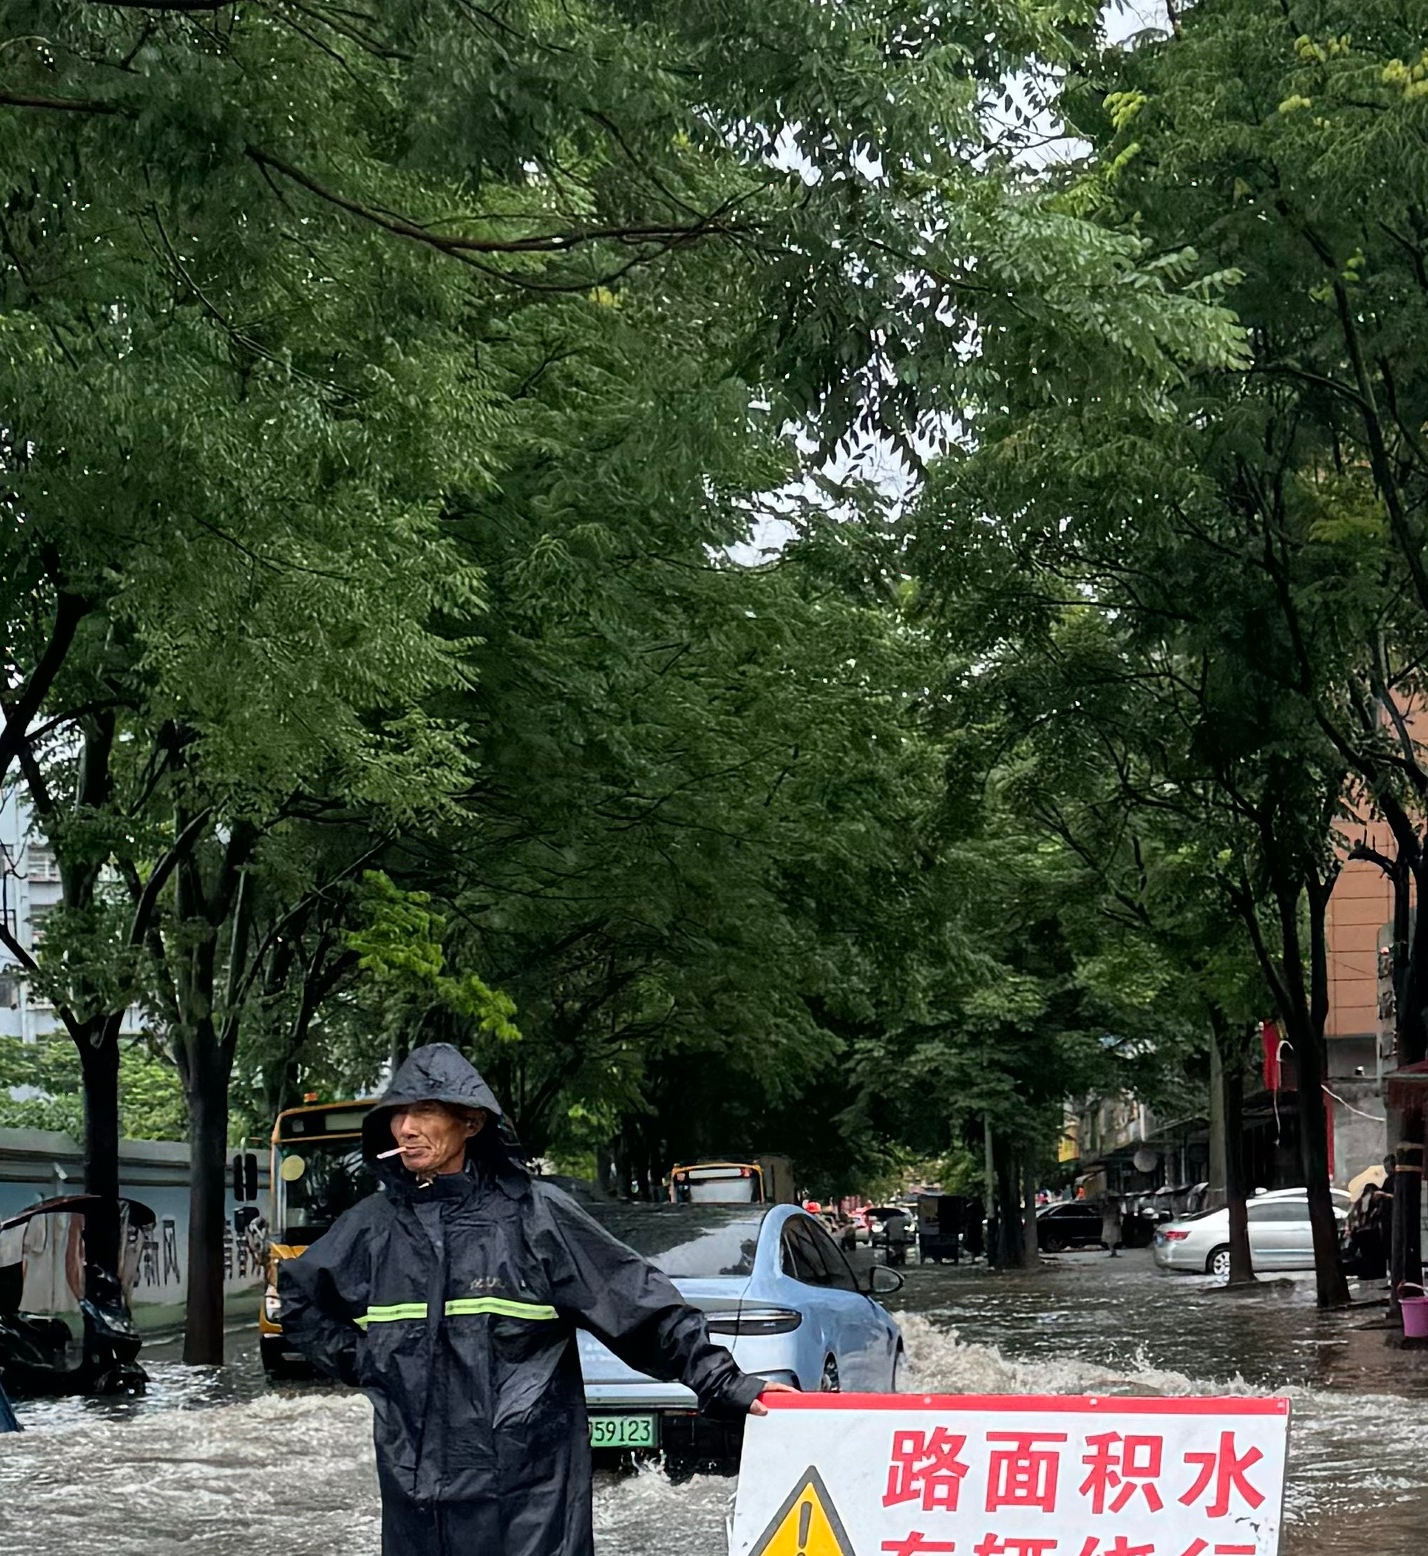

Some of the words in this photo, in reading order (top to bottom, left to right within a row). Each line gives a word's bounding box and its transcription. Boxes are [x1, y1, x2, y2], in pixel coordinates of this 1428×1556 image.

[588, 1420, 651, 1442] 59123
[882, 1426, 1266, 1518] 路面积水
